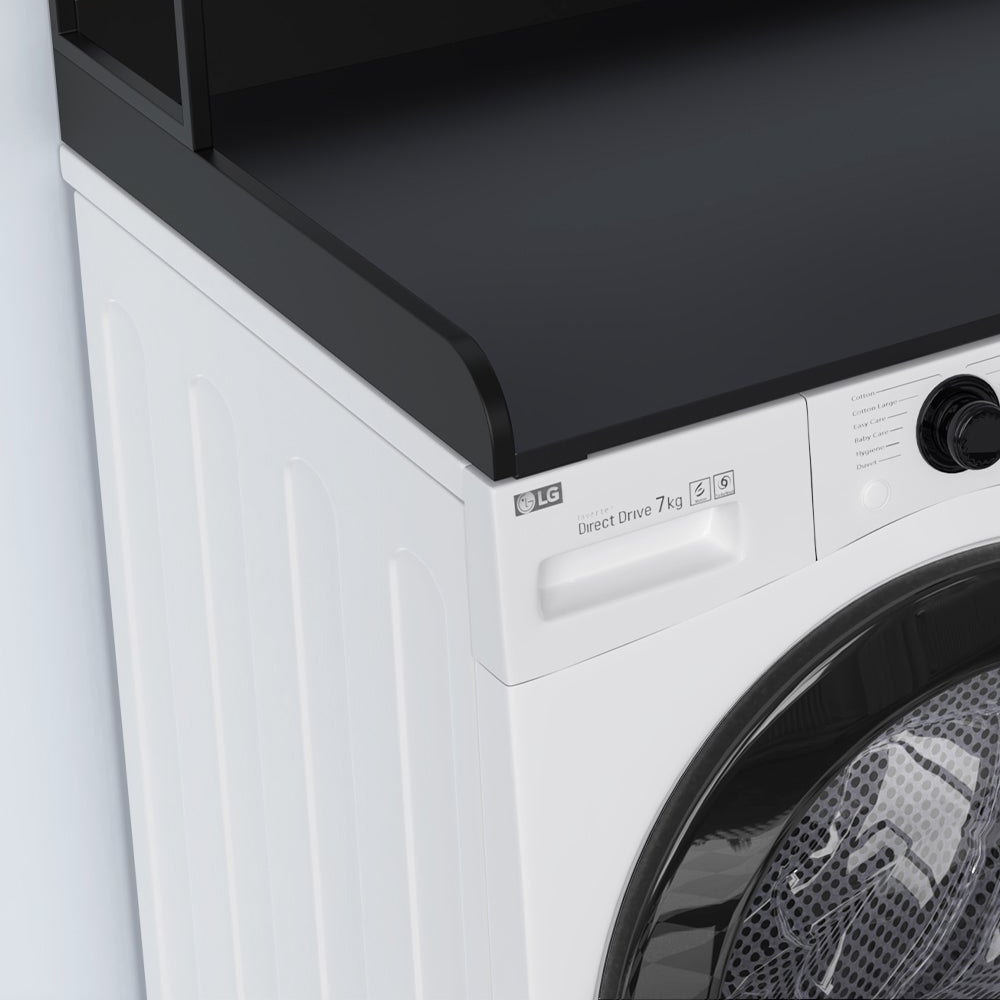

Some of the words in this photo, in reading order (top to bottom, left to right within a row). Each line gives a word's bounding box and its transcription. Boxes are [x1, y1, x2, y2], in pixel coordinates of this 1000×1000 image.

[851, 391, 876, 402] Cotton
[852, 406, 876, 417] Cotton
[877, 400, 898, 409] Large
[854, 435, 872, 444] Baby
[872, 430, 889, 438] Care
[855, 446, 885, 456] Hygiene
[856, 460, 877, 470] Duvet
[537, 486, 560, 505] LG
[578, 515, 615, 535] Direct
[618, 505, 652, 525] Drive
